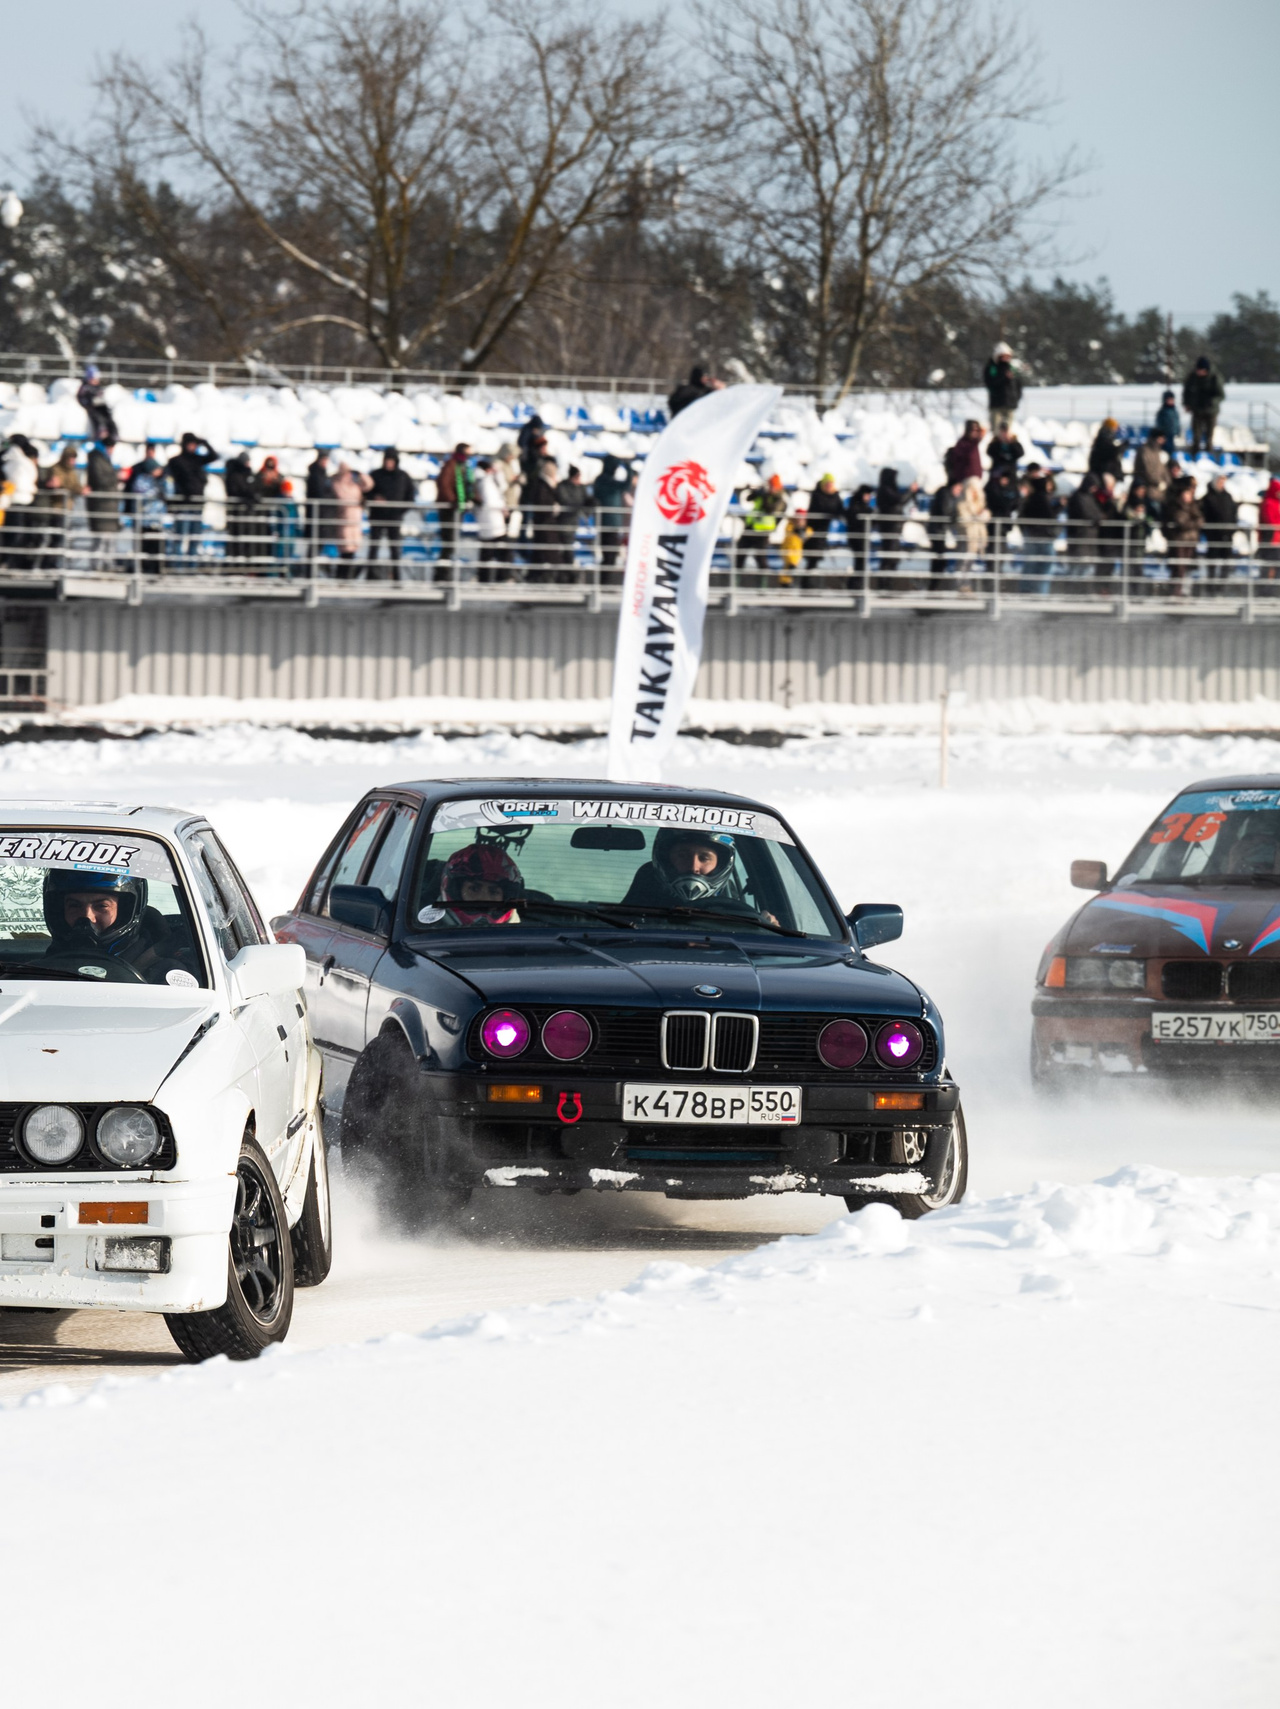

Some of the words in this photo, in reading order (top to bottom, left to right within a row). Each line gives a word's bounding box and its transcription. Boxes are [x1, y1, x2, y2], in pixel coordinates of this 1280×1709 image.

[632, 560, 648, 617] MOTOR
[630, 534, 689, 743] TAKAYAMA
[503, 802, 558, 812] DRIFT
[573, 801, 679, 822] WINTER
[682, 805, 756, 830] MODE
[1149, 812, 1227, 844] 36
[40, 839, 141, 867] MODE
[1246, 1014, 1278, 1030] 750
[751, 1091, 792, 1112] 550
[760, 1113, 780, 1121] RUS
